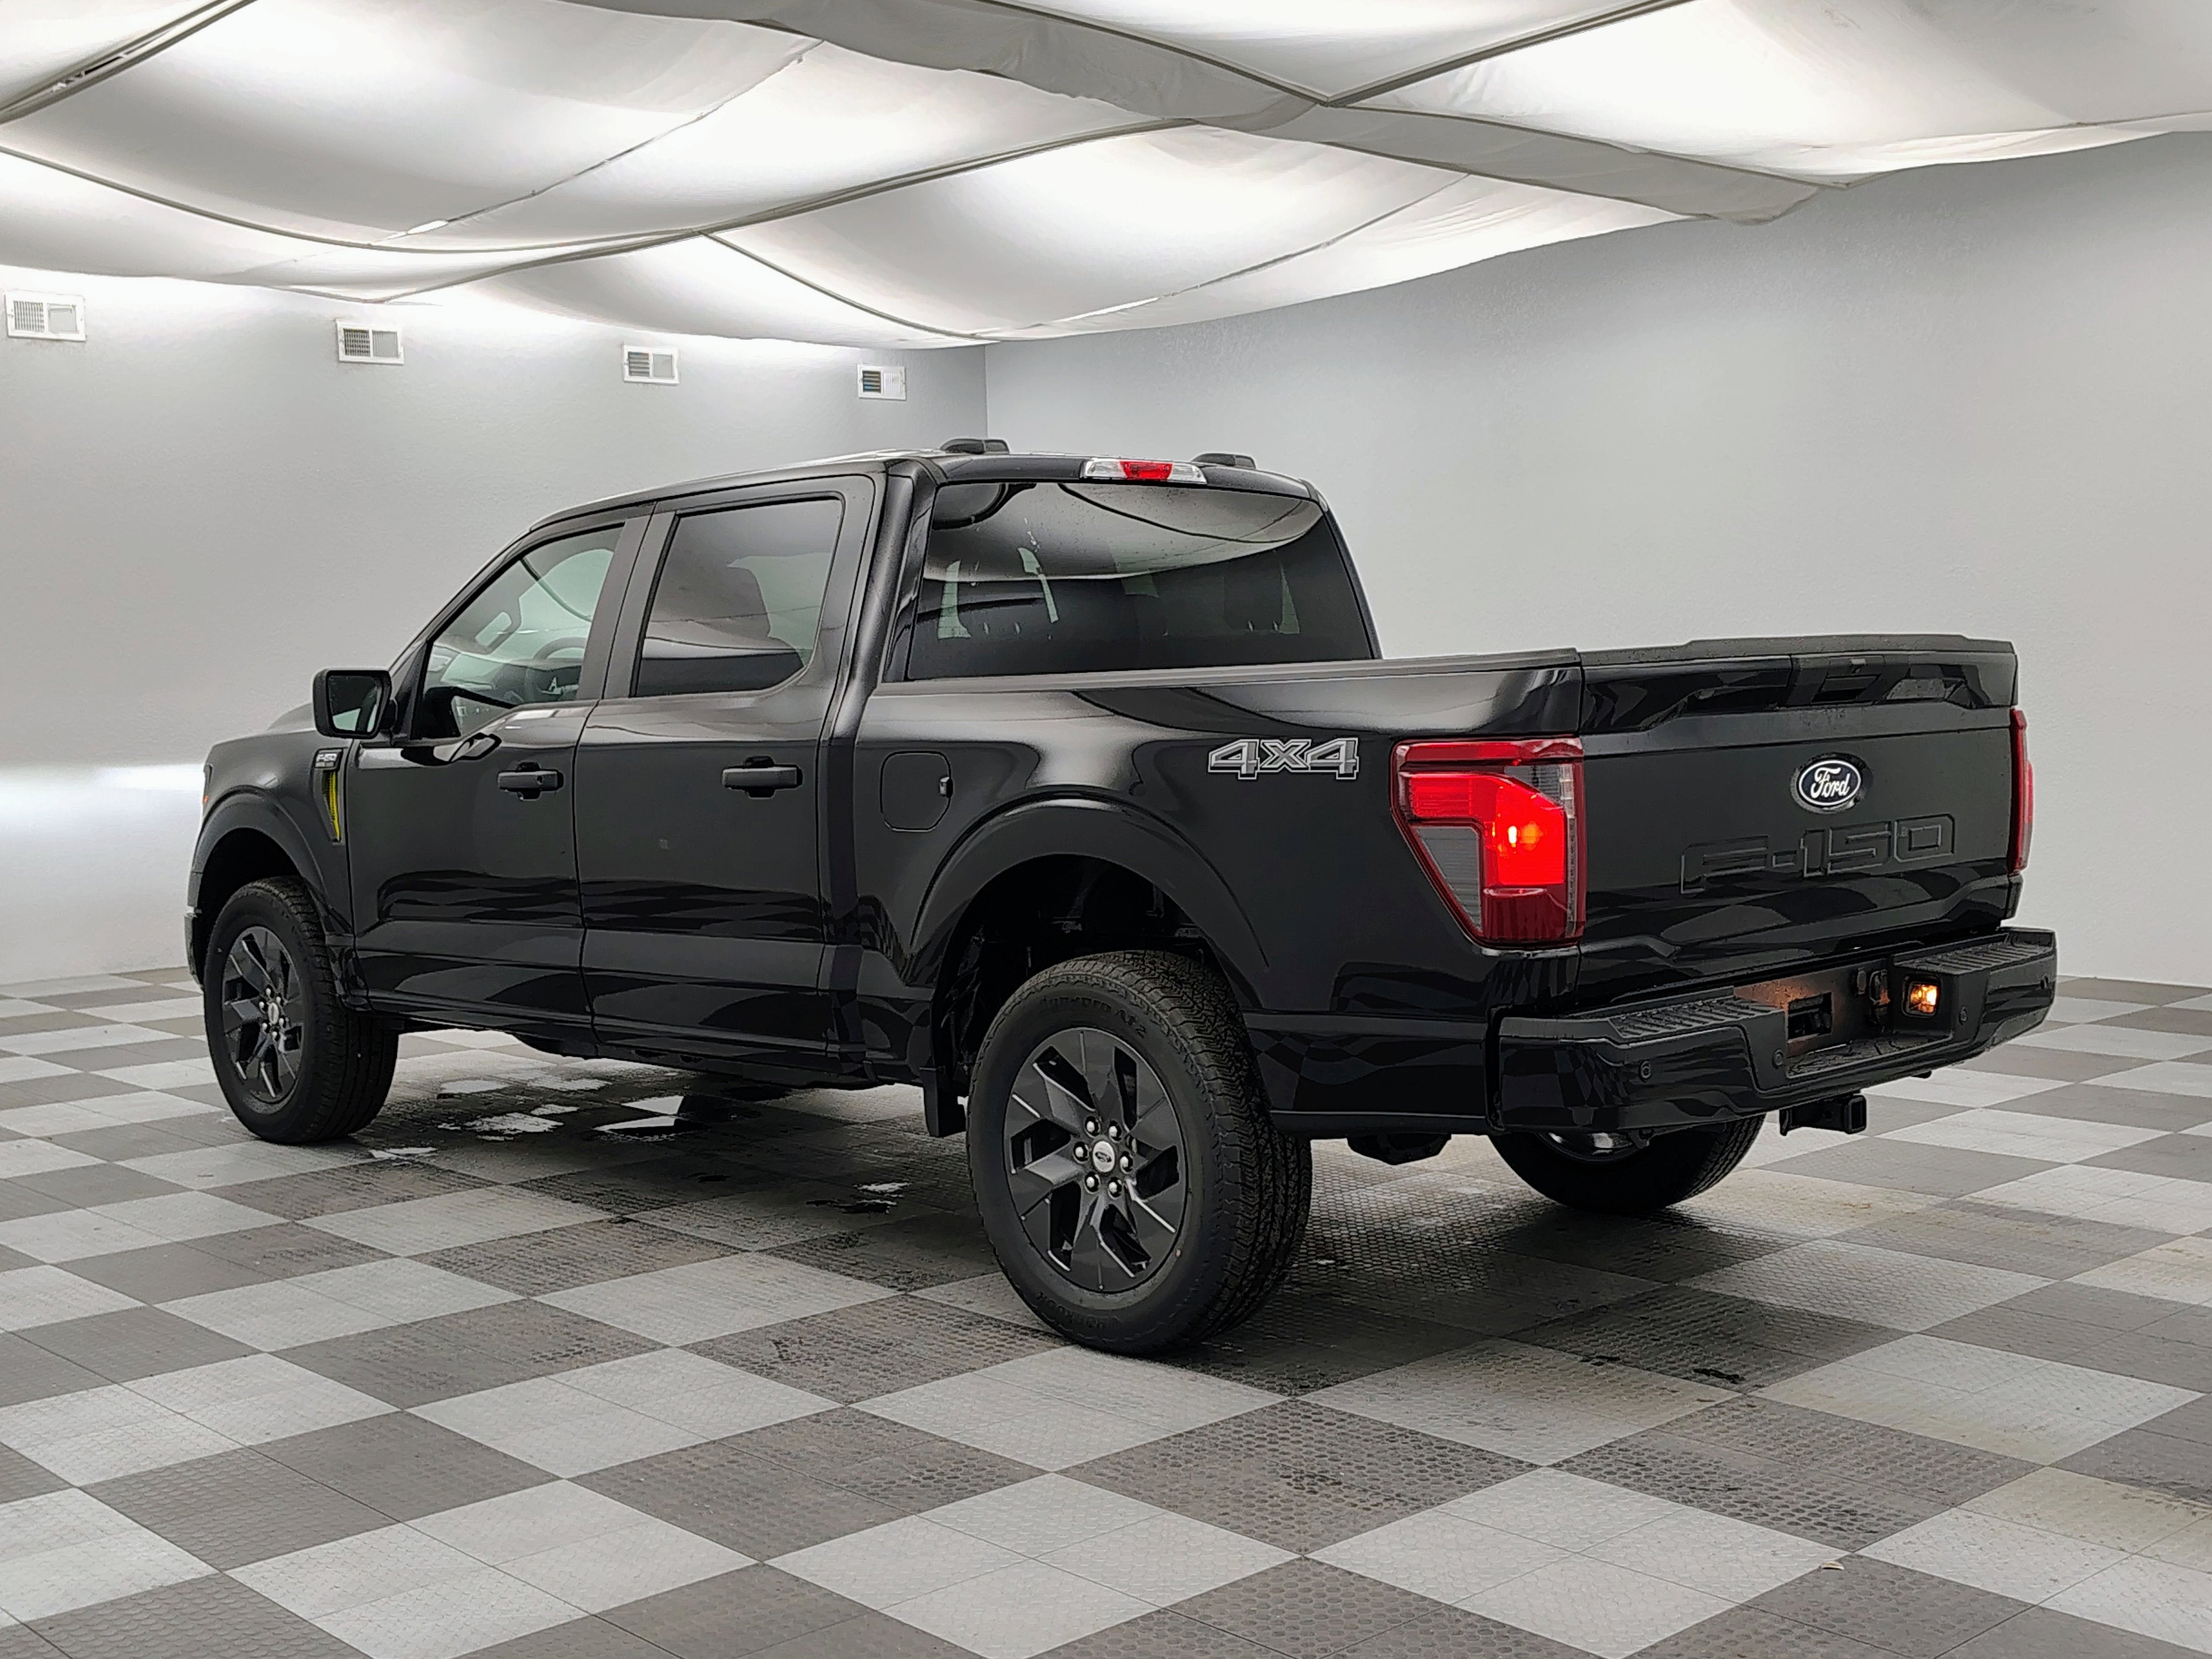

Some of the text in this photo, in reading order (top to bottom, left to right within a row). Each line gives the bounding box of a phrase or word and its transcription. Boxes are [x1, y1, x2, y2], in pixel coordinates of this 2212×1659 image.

[1208, 737, 1359, 779] 4X4
[1810, 767, 1851, 799] Ford
[1681, 813, 1955, 894] F-150
